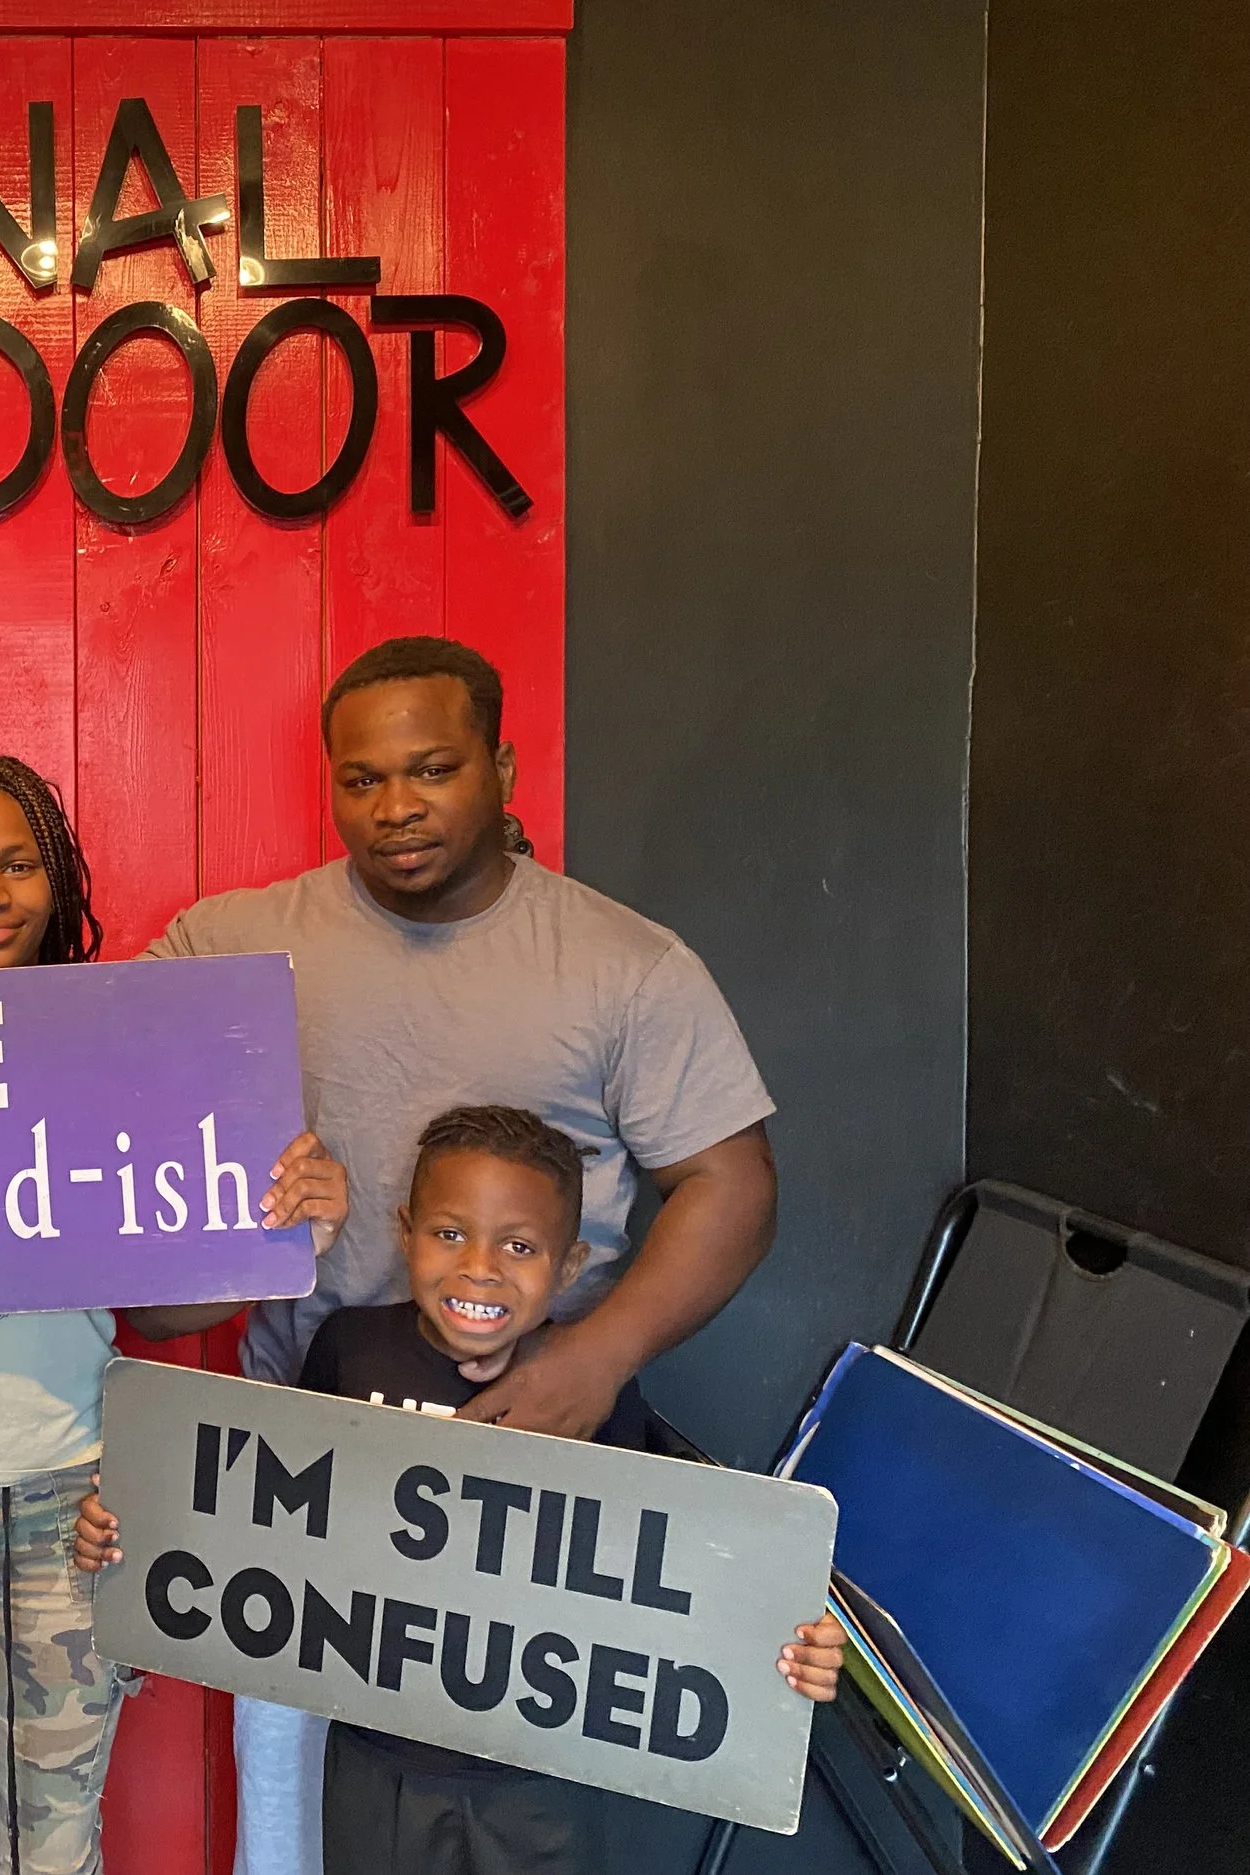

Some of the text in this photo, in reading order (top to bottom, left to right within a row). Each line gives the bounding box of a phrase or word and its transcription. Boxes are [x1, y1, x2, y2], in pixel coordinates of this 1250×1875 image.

[192, 1422, 692, 1616] I'M STILL
[144, 1550, 729, 1763] CONFUSED
